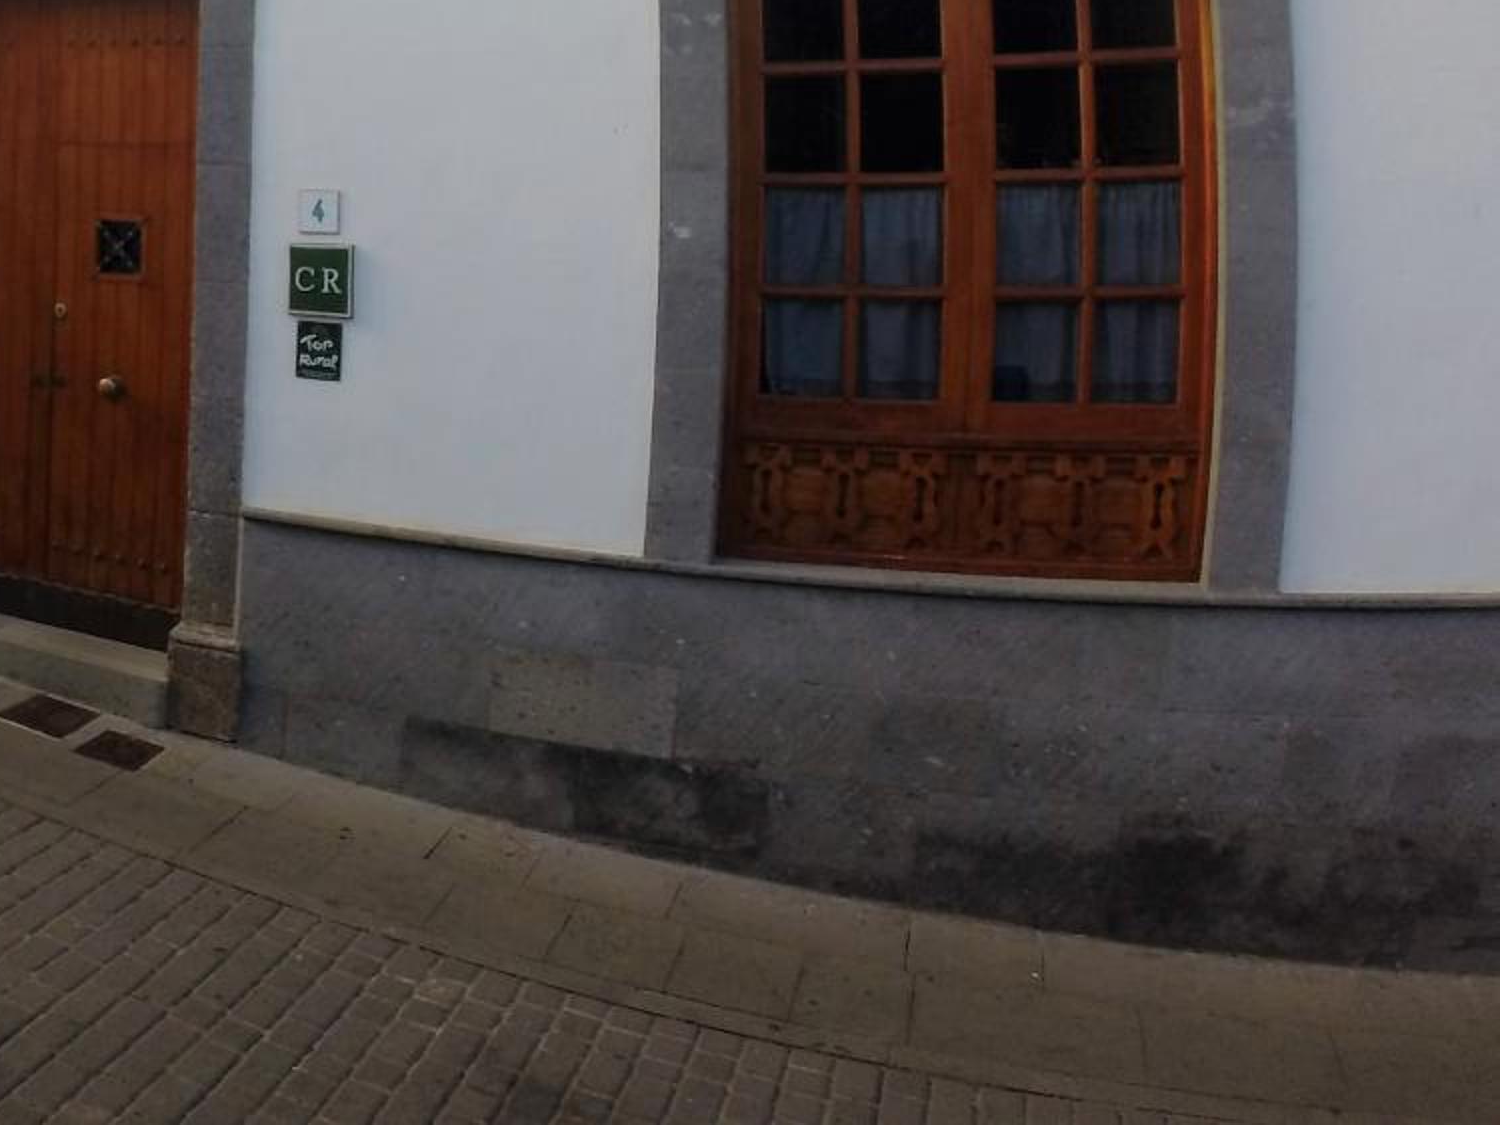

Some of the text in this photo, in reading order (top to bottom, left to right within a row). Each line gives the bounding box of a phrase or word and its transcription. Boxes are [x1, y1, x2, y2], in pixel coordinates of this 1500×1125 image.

[312, 198, 325, 223] 4
[300, 334, 334, 352] Top
[299, 354, 339, 371] Rural
